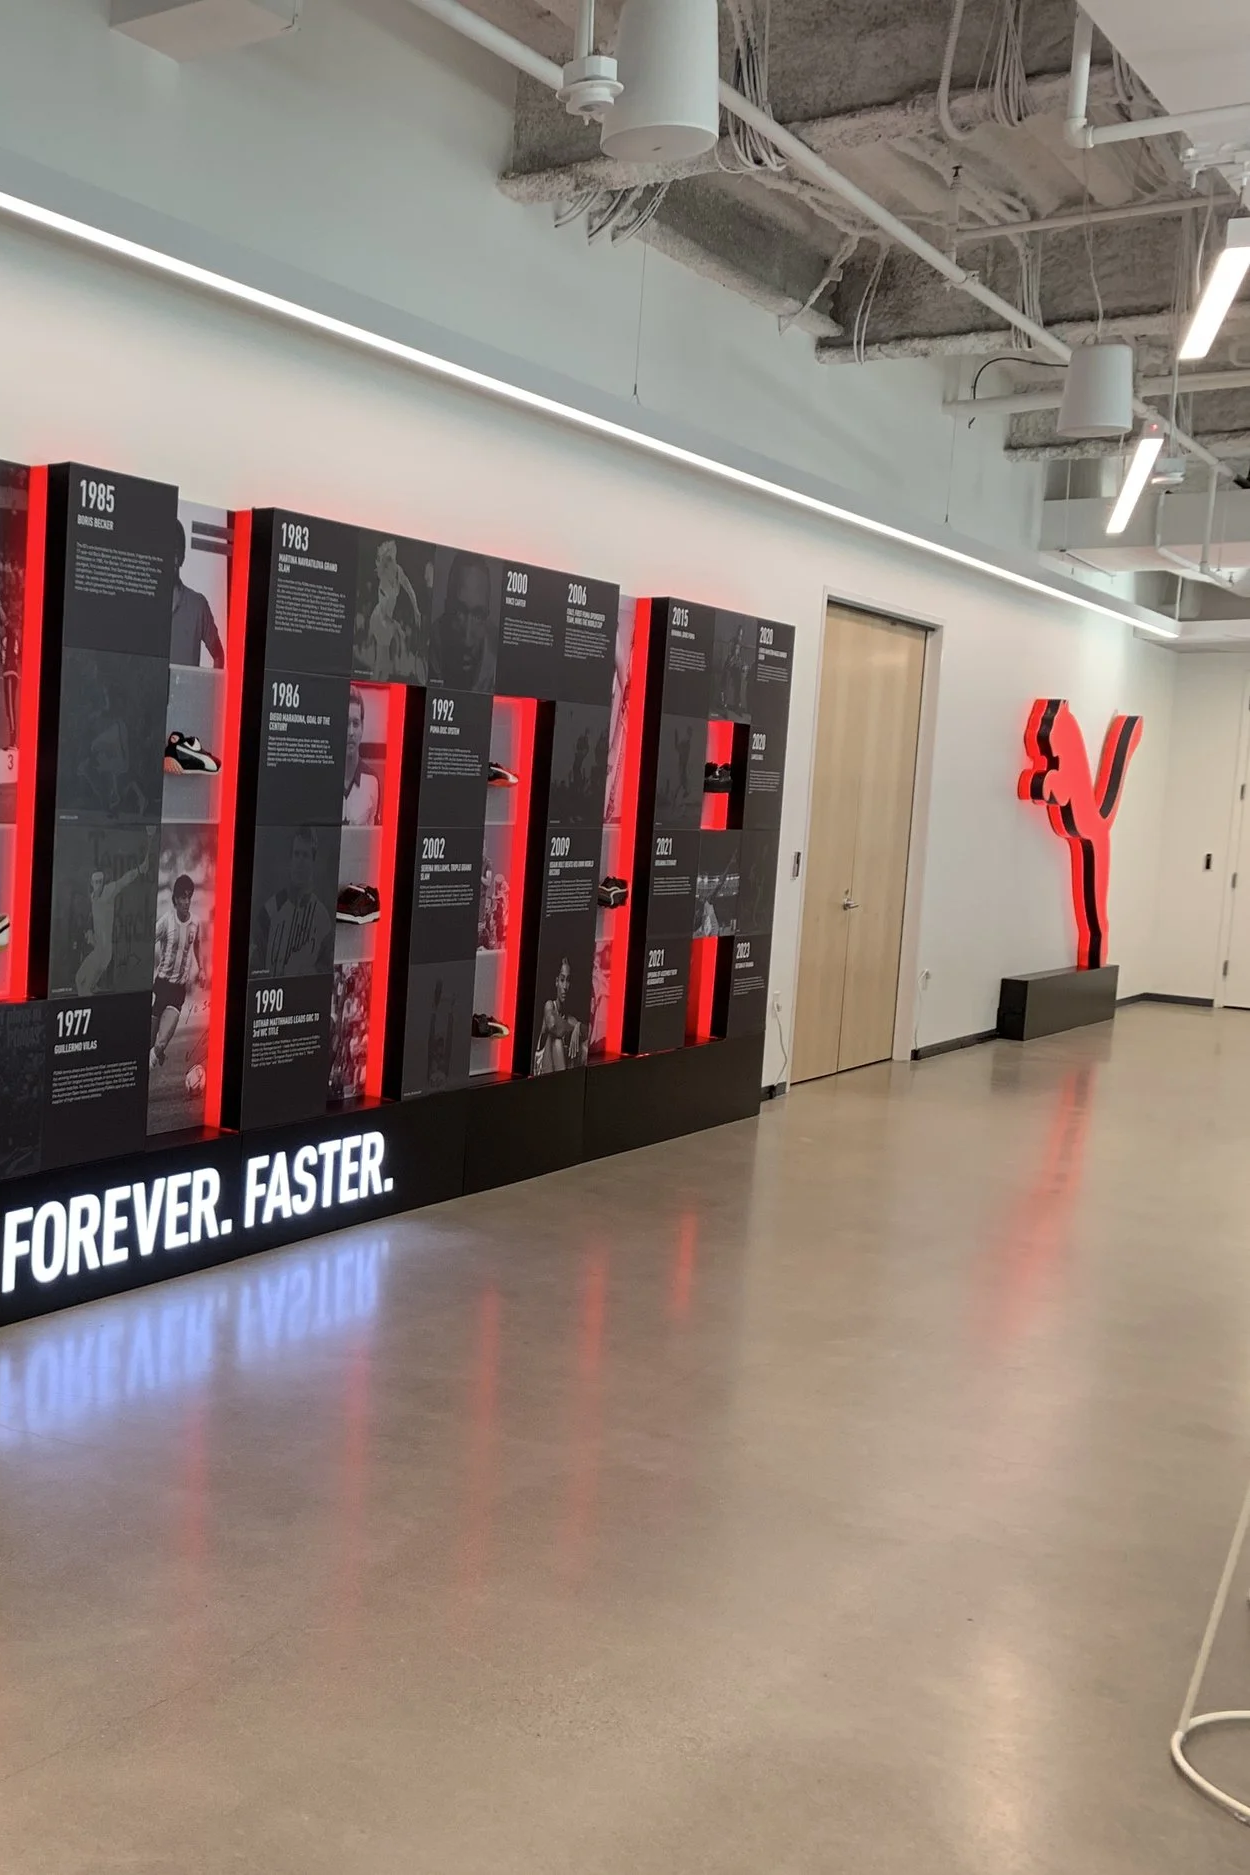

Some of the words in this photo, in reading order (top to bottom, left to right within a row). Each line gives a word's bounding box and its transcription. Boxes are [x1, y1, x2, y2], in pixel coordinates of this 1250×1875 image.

[80, 480, 115, 512] 1985
[78, 514, 93, 527] BORIS
[94, 517, 114, 530] BECKER
[282, 522, 309, 551] 1983
[278, 563, 290, 573] SLAM
[279, 553, 297, 564] MARTINA
[324, 562, 338, 572] GRAND
[507, 571, 528, 594] 2000
[568, 583, 587, 606] 2006
[672, 606, 689, 627] 2015
[272, 682, 300, 708] 1986
[432, 698, 454, 721] 1992
[269, 722, 288, 731] CENTURY
[8, 754, 13, 770] 3
[422, 837, 445, 859] 2002
[551, 837, 570, 856] 2009
[656, 838, 672, 855] 2021
[648, 949, 664, 967] 2021
[255, 988, 283, 1014] 1990
[57, 1008, 91, 1038] 1977
[54, 1042, 82, 1054] GUILLERMO
[82, 1040, 97, 1050] VILAS
[1, 1167, 232, 1294] FOREVER.
[244, 1131, 394, 1229] FASTER.
